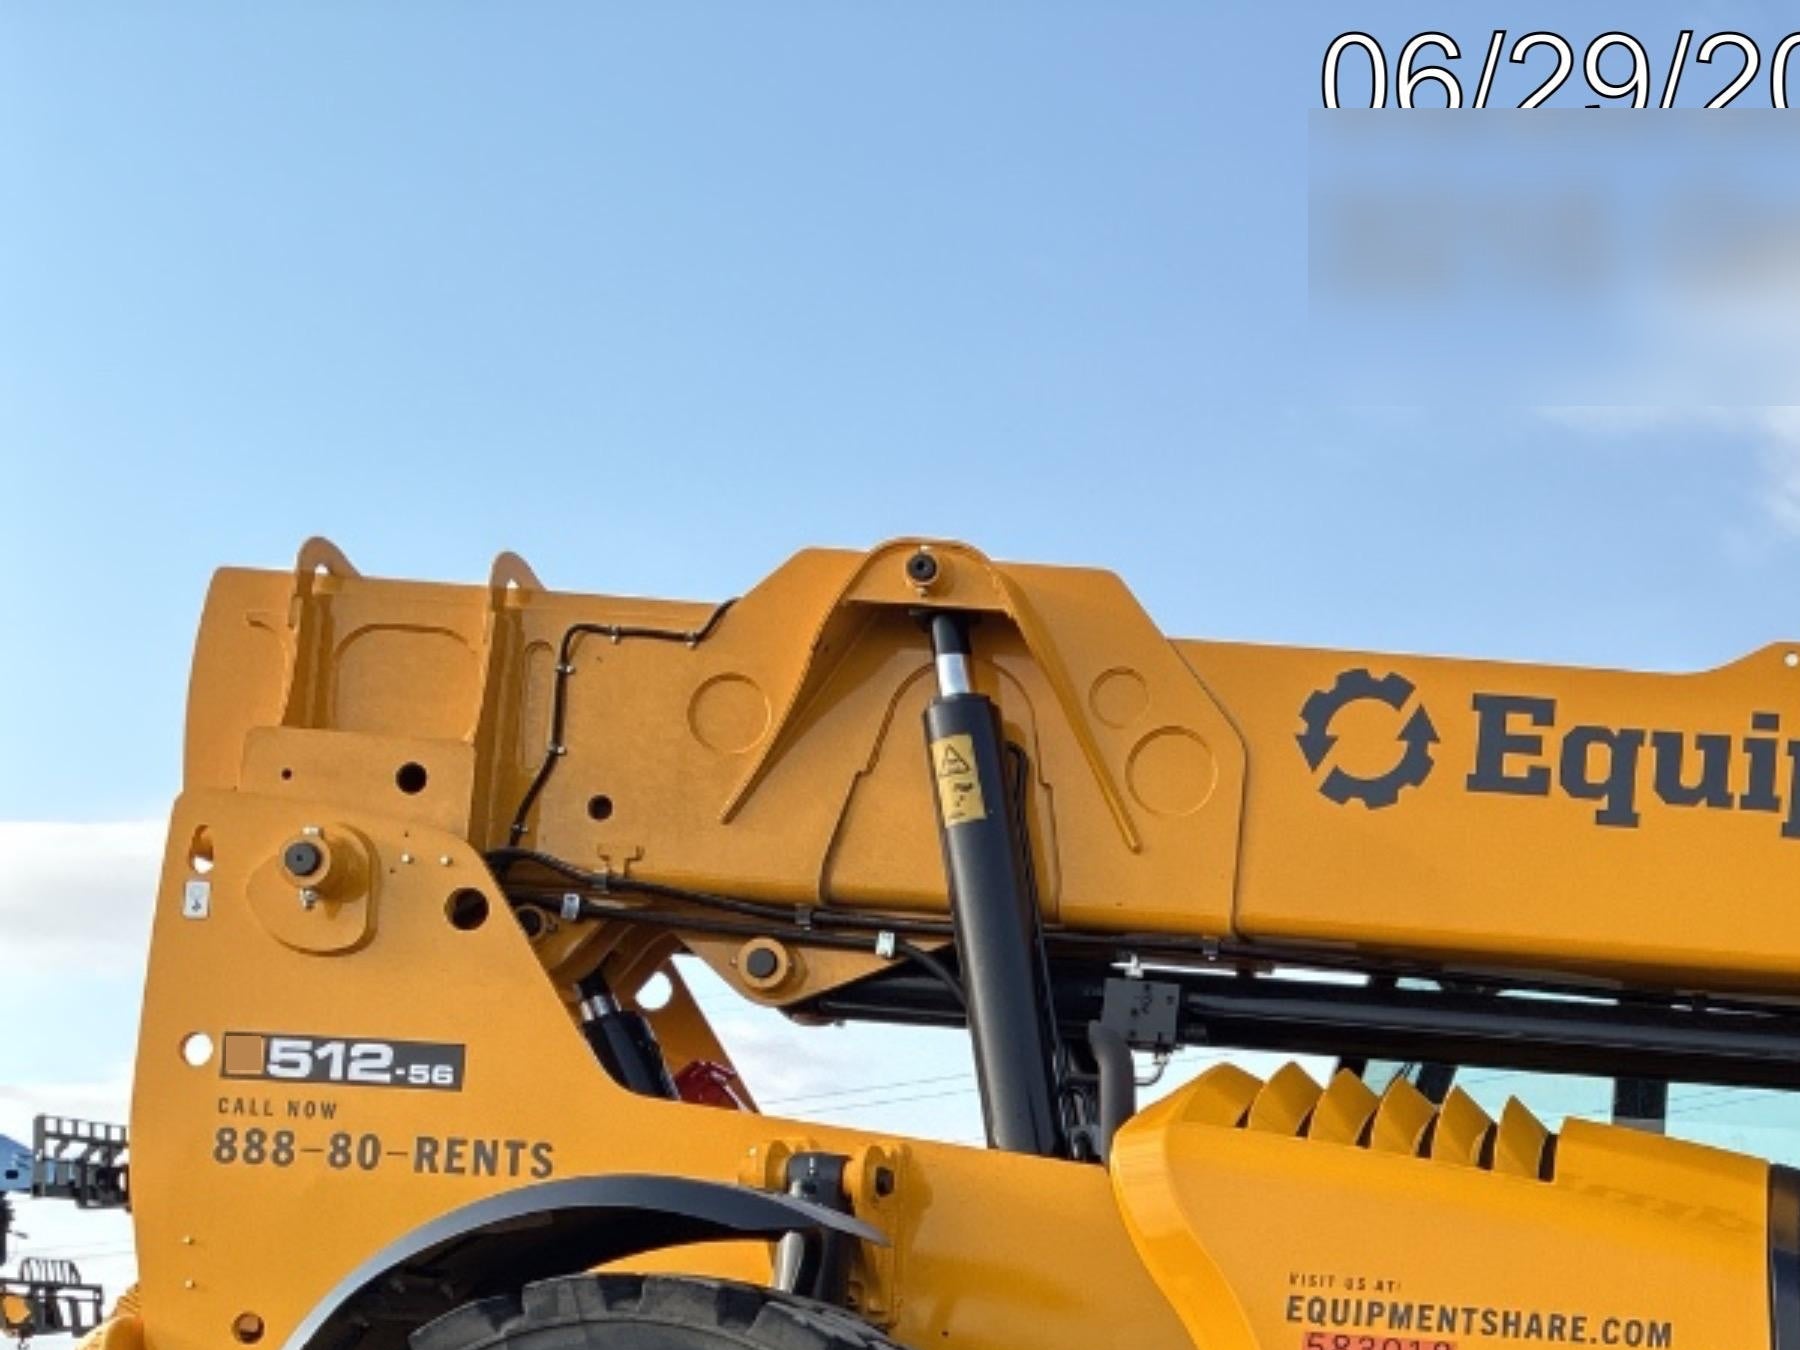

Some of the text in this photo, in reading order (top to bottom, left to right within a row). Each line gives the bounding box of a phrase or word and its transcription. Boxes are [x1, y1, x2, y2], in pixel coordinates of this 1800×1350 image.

[266, 1037, 454, 1085] 512-56
[217, 1097, 337, 1120] CALL NOW
[213, 1127, 554, 1179] 888-80-RENTS
[1288, 1271, 1336, 1289] VISIT
[1343, 1276, 1366, 1291] US
[1285, 1295, 1673, 1350] EQUIPMENTSHARE.COM
